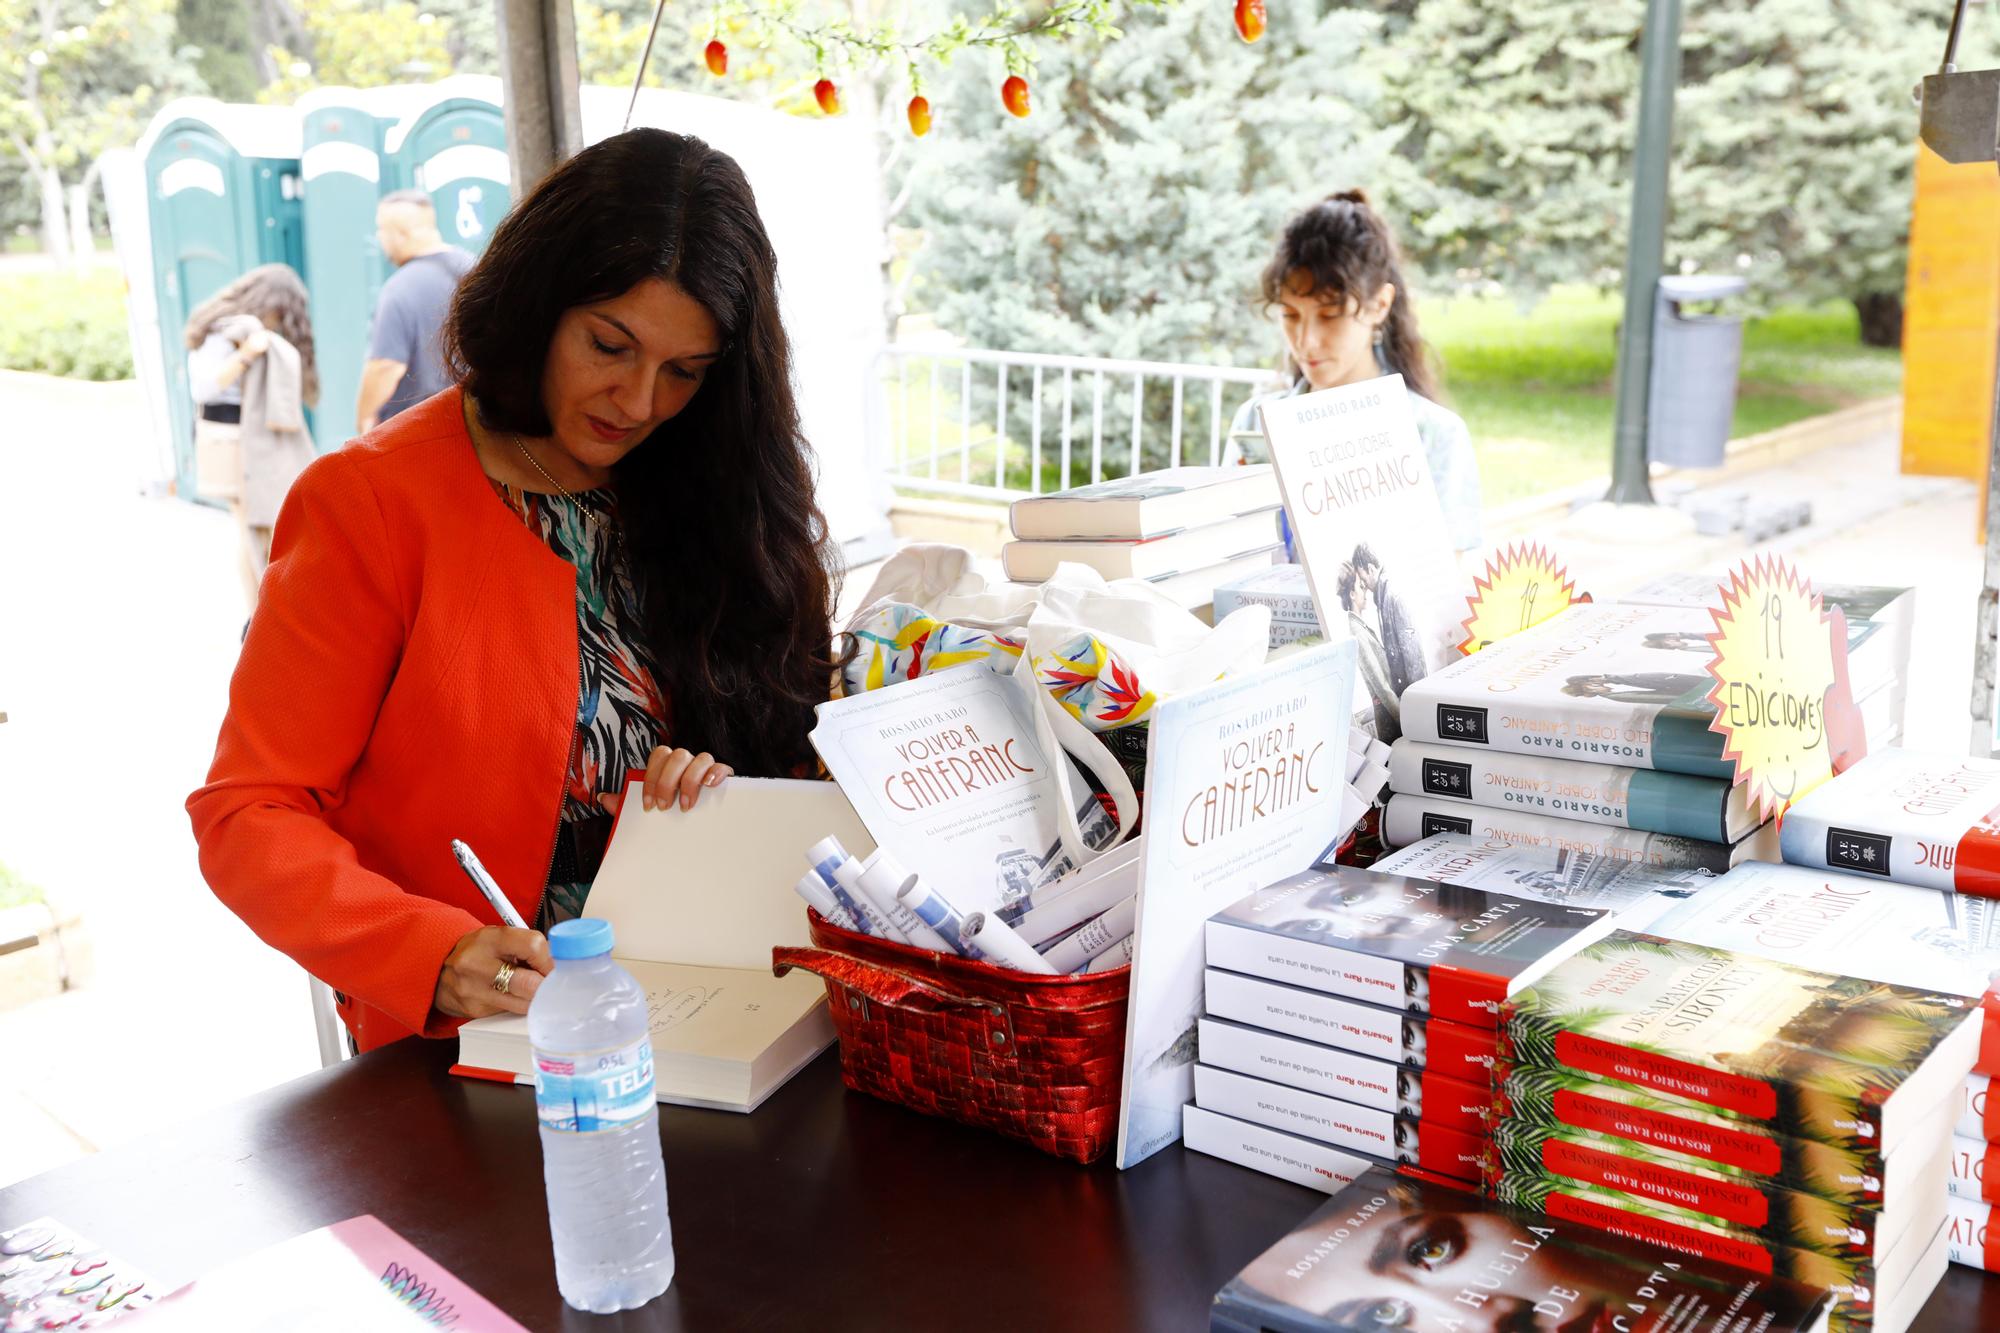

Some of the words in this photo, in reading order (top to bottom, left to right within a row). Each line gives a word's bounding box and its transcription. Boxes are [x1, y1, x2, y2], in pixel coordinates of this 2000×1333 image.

[1297, 402, 1348, 424] ROSARIO
[1351, 394, 1381, 411] RARO
[1302, 454, 1420, 515] CANFRANC
[1760, 591, 1784, 660] 19
[879, 715, 934, 739] ROSARIO
[935, 707, 968, 724] RARO
[1219, 706, 1273, 740] ROSARIO
[1275, 696, 1307, 717] RARO
[1730, 674, 1822, 750] EDICIONES
[895, 730, 963, 763] VOLVER
[964, 725, 980, 744] A
[1223, 729, 1283, 771] VOLVER
[1286, 722, 1295, 749] A
[1522, 735, 1563, 749] RARO
[1571, 741, 1644, 757] ROSARIO
[885, 738, 1034, 812] CANFRANC
[1182, 741, 1324, 847] CANFRANC
[1504, 792, 1545, 806] RARO
[1552, 799, 1623, 818] ROSARIO
[1426, 841, 1511, 882] ANFRANC
[1417, 934, 1465, 959] UNA
[1460, 900, 1521, 932] CARTA
[1756, 884, 1871, 949] CANFRANC
[1581, 957, 1640, 997] ROSARIO
[1608, 967, 1650, 996] RARO
[1621, 957, 1734, 1033] DESAPARECIDA
[1614, 1064, 1648, 1081] RARO
[1653, 1076, 1709, 1097] ROSARIO
[1615, 1121, 1649, 1138] RARO
[1654, 1132, 1711, 1153] ROSARIO
[1603, 1171, 1638, 1188] RARO
[1642, 1182, 1699, 1204] ROSARIO
[1286, 1228, 1350, 1279] ROSARIO
[1346, 1196, 1387, 1228] RARO
[1456, 1224, 1556, 1309] HUELLA
[1533, 1285, 1580, 1320] DE
